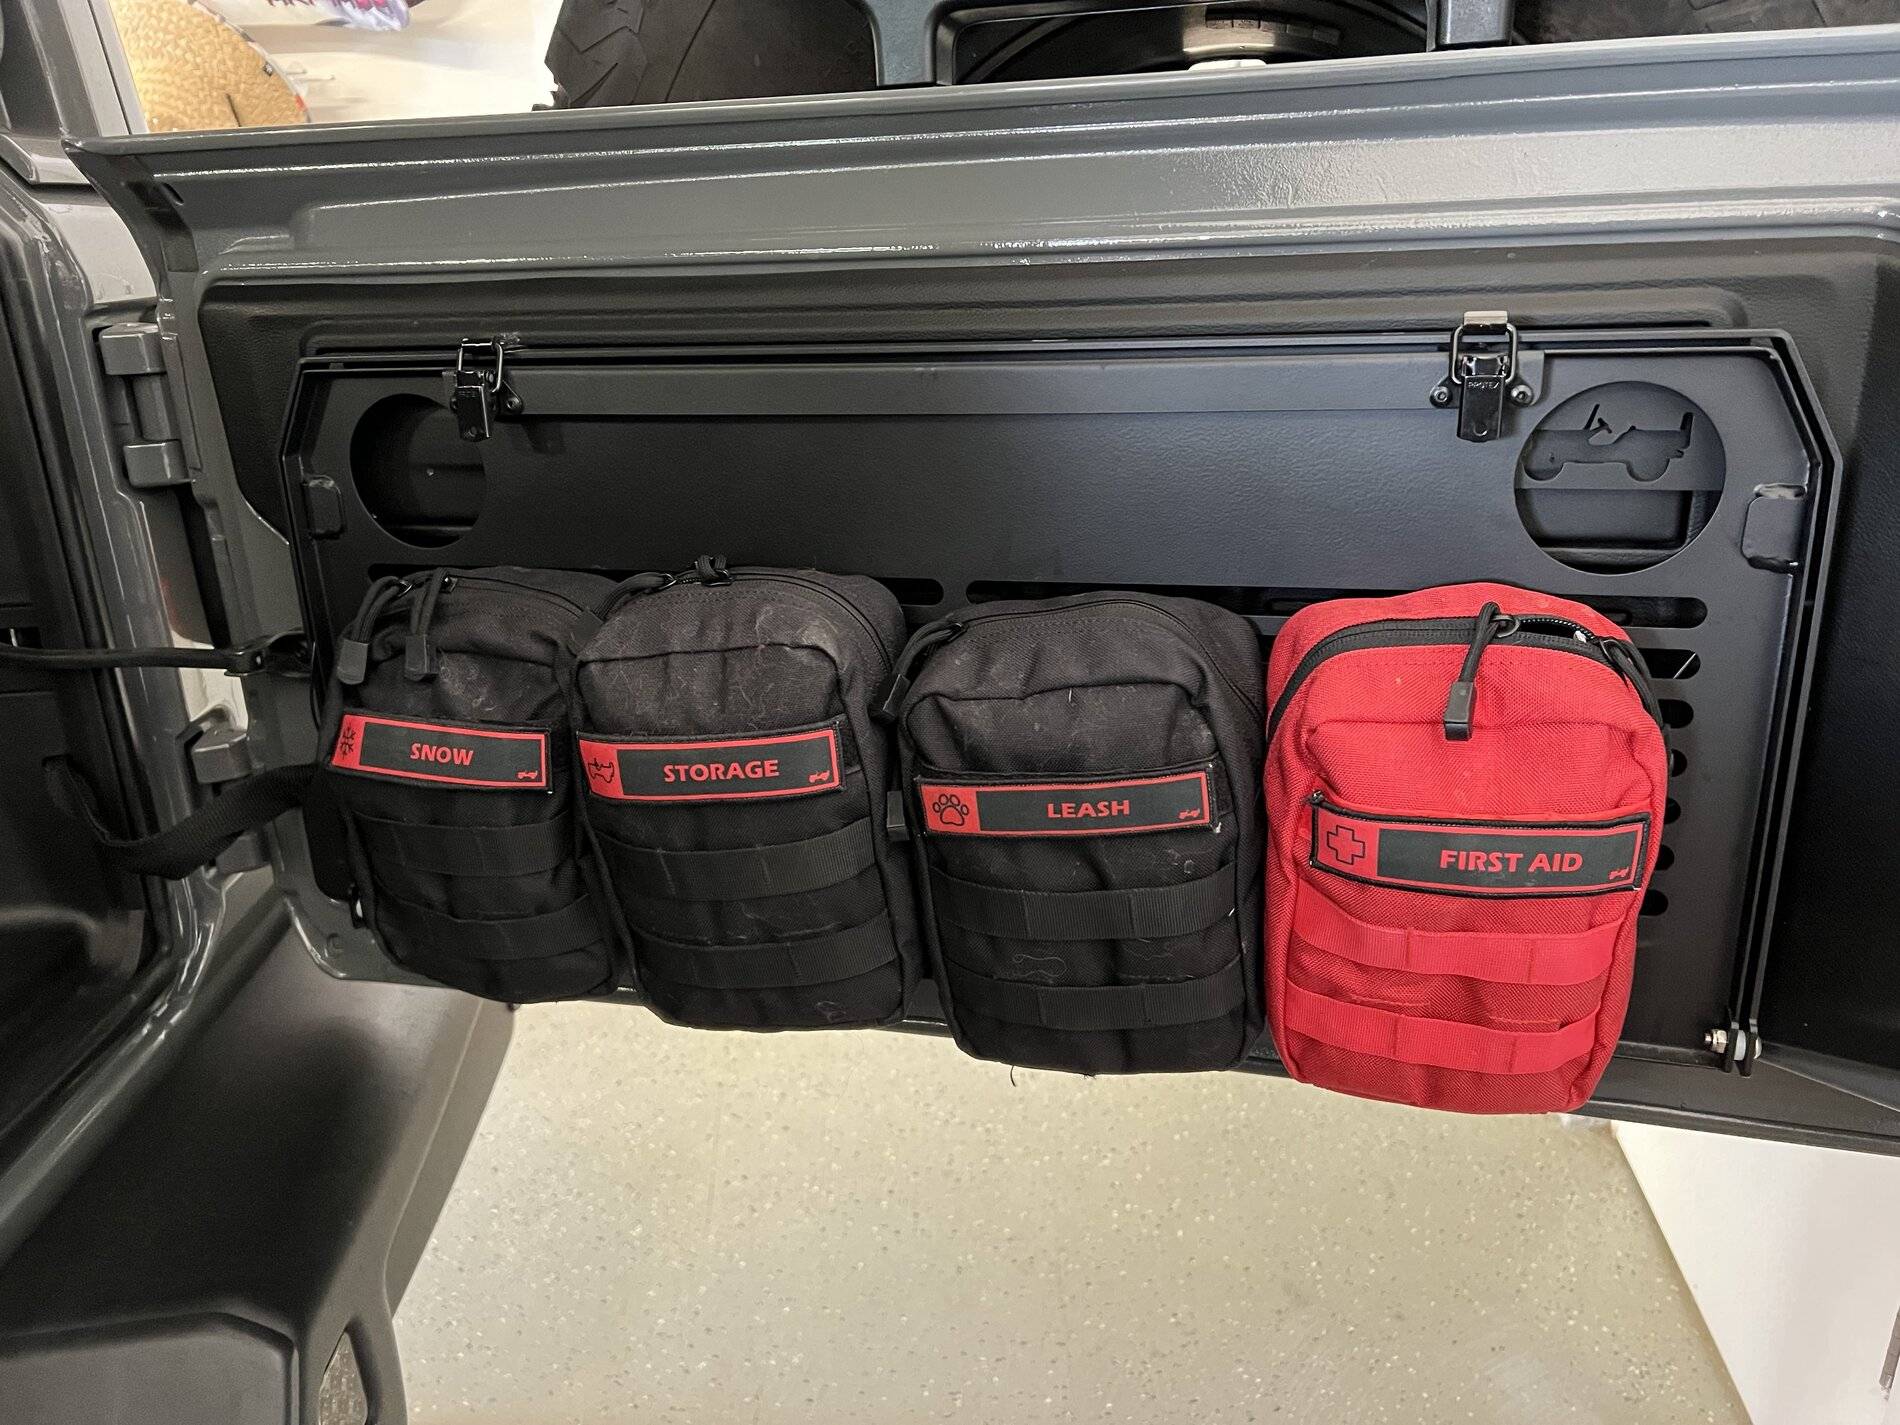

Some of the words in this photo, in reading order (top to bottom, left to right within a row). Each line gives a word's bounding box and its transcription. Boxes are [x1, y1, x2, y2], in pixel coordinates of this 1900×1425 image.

[410, 743, 474, 766] SNOW
[663, 759, 780, 782] STORAGE
[1047, 799, 1130, 818] LEASH
[1440, 849, 1524, 873] FIRST
[1528, 853, 1583, 873] AID
